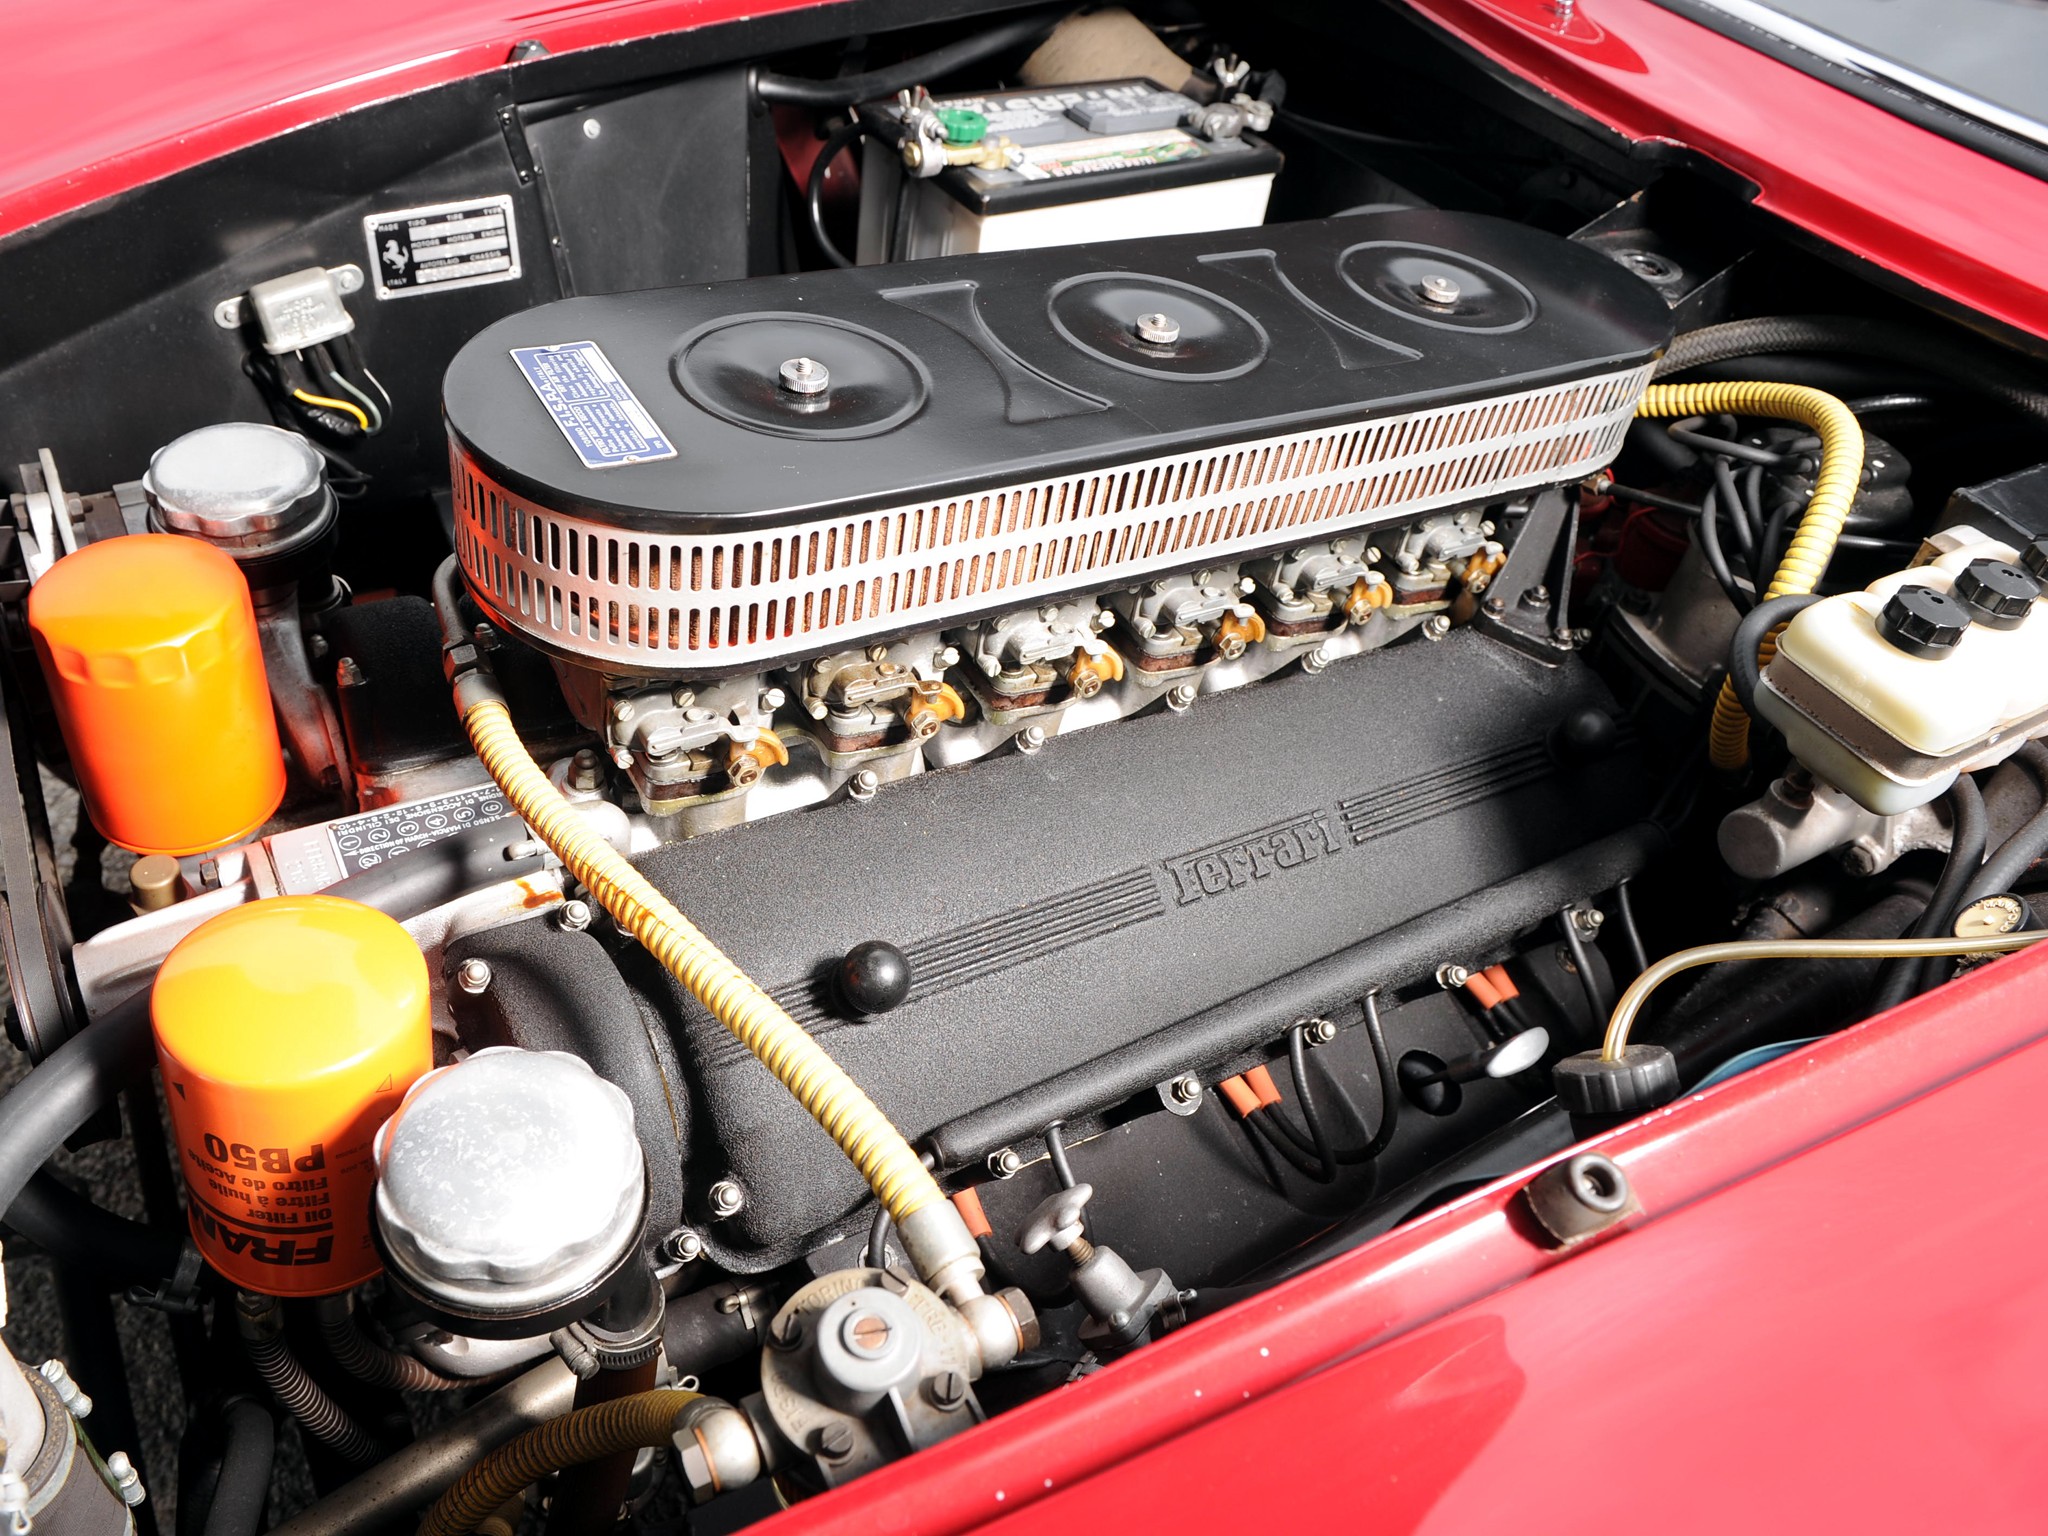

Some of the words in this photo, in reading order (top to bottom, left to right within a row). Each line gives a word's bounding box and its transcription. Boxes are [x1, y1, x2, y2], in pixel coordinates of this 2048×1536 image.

[469, 251, 502, 262] CHASSIS
[386, 278, 408, 287] ITALY
[405, 801, 462, 820] ACCENSIONE
[385, 816, 401, 825] DEI
[473, 814, 501, 826] SENSO
[337, 821, 383, 836] CILINDRI
[359, 841, 396, 855] DIRECTION
[1164, 809, 1341, 907] Ferrari
[204, 1133, 325, 1173] PB50
[188, 1149, 236, 1185] Aceite
[209, 1178, 251, 1204] huile
[242, 1177, 266, 1190] de
[273, 1176, 328, 1192] Filtro
[257, 1196, 269, 1207] à
[276, 1192, 330, 1208] Filtre
[247, 1208, 298, 1224] Filter
[305, 1208, 332, 1222] Oil
[190, 1200, 334, 1266] FRAM
